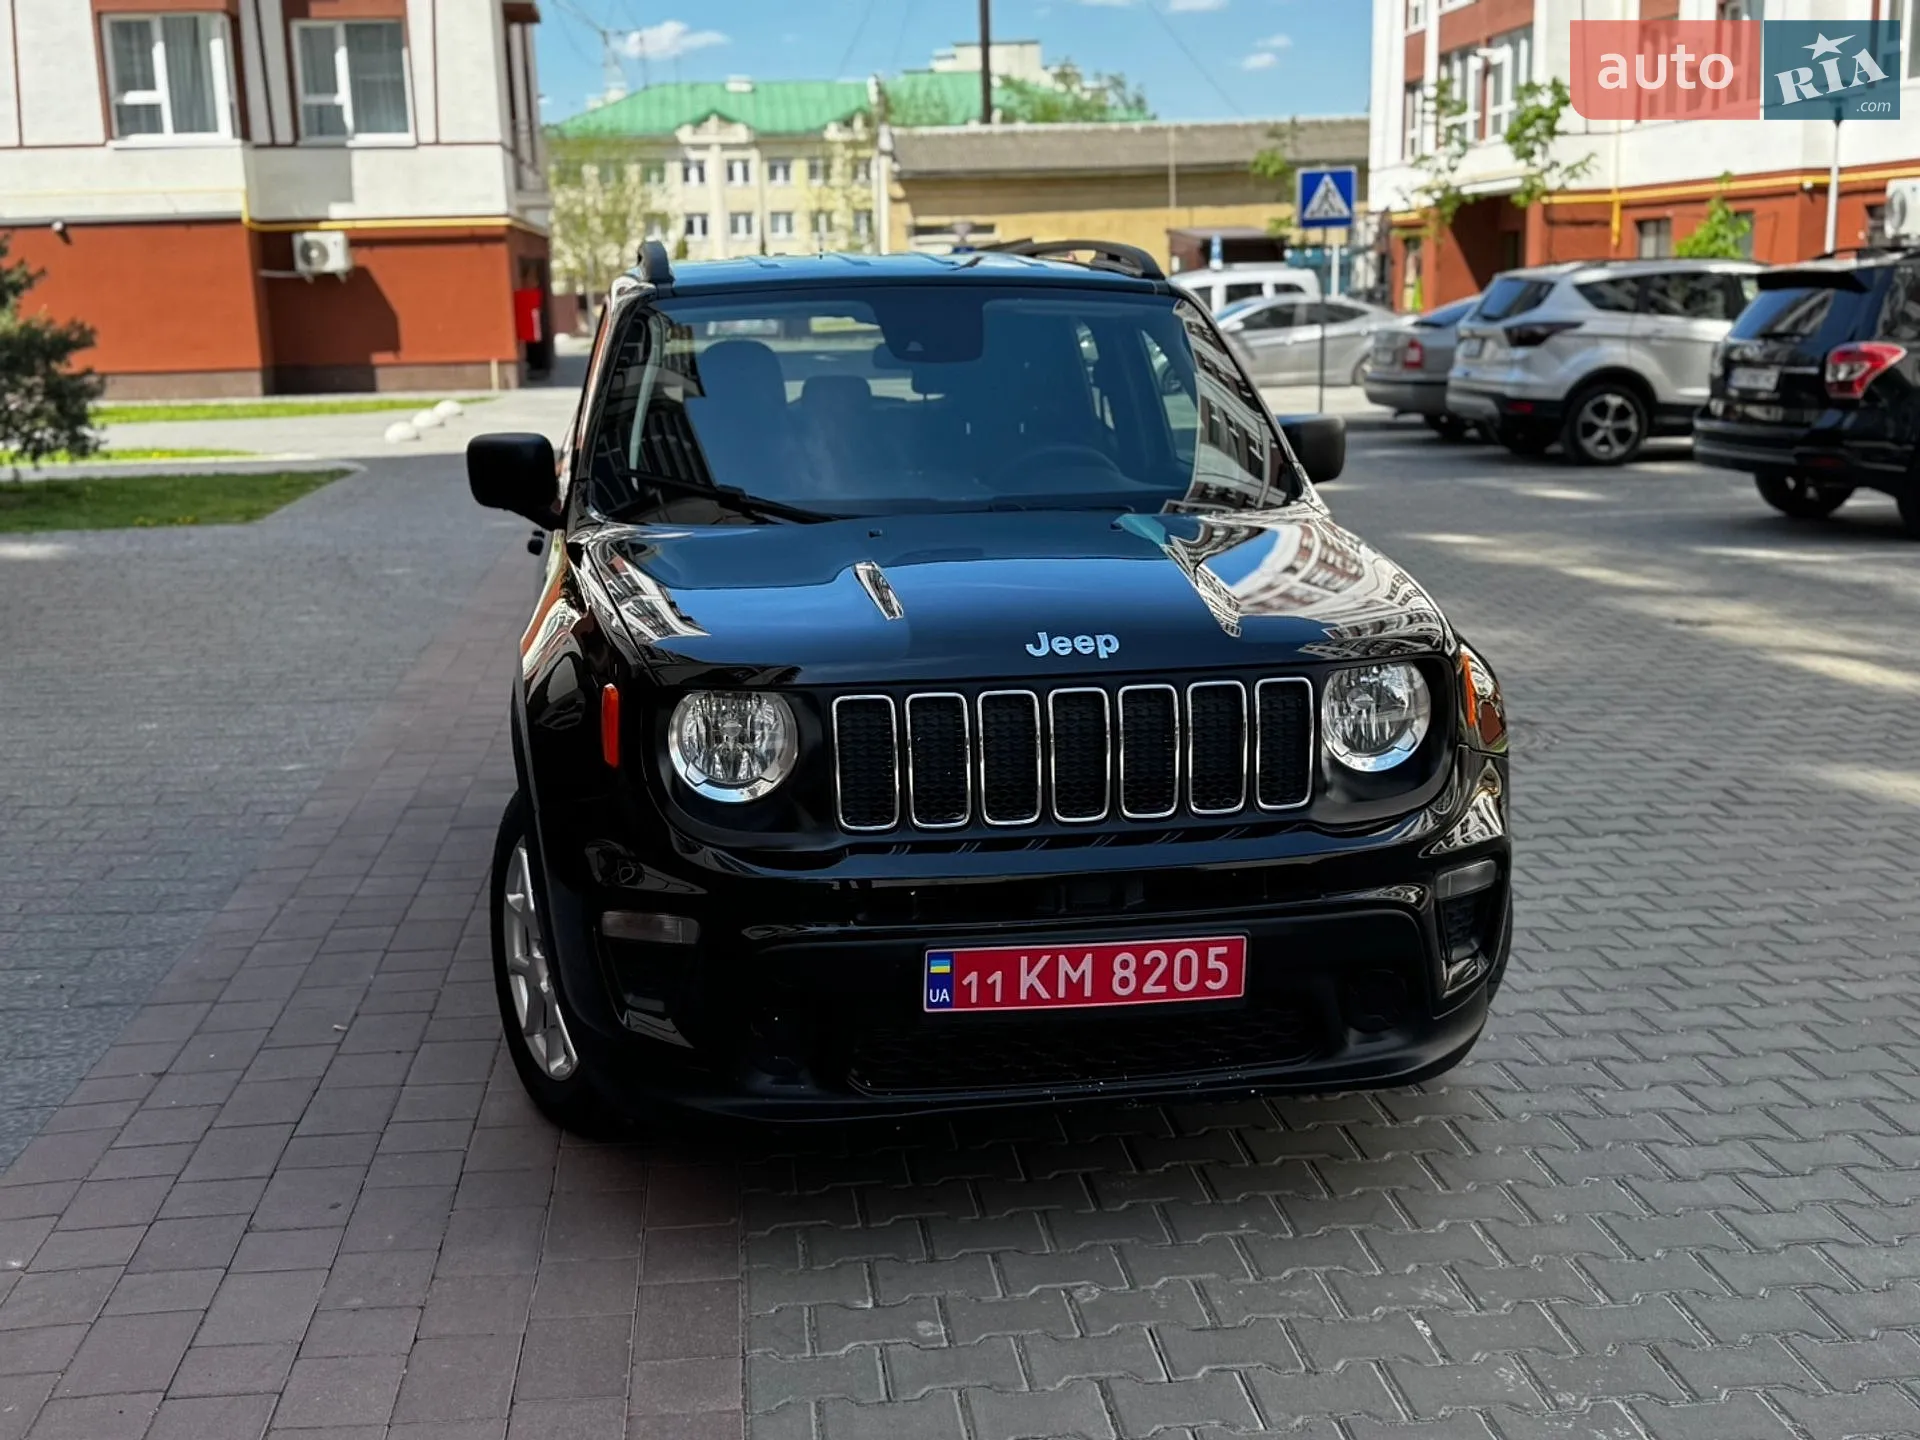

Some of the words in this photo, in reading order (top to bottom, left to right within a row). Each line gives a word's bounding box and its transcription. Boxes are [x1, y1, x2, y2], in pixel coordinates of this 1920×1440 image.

[1025, 631, 1120, 659] Jeep
[962, 971, 1003, 1003] 11
[1019, 953, 1093, 1001] KM
[1111, 946, 1229, 996] 8205
[929, 988, 950, 1003] UA
